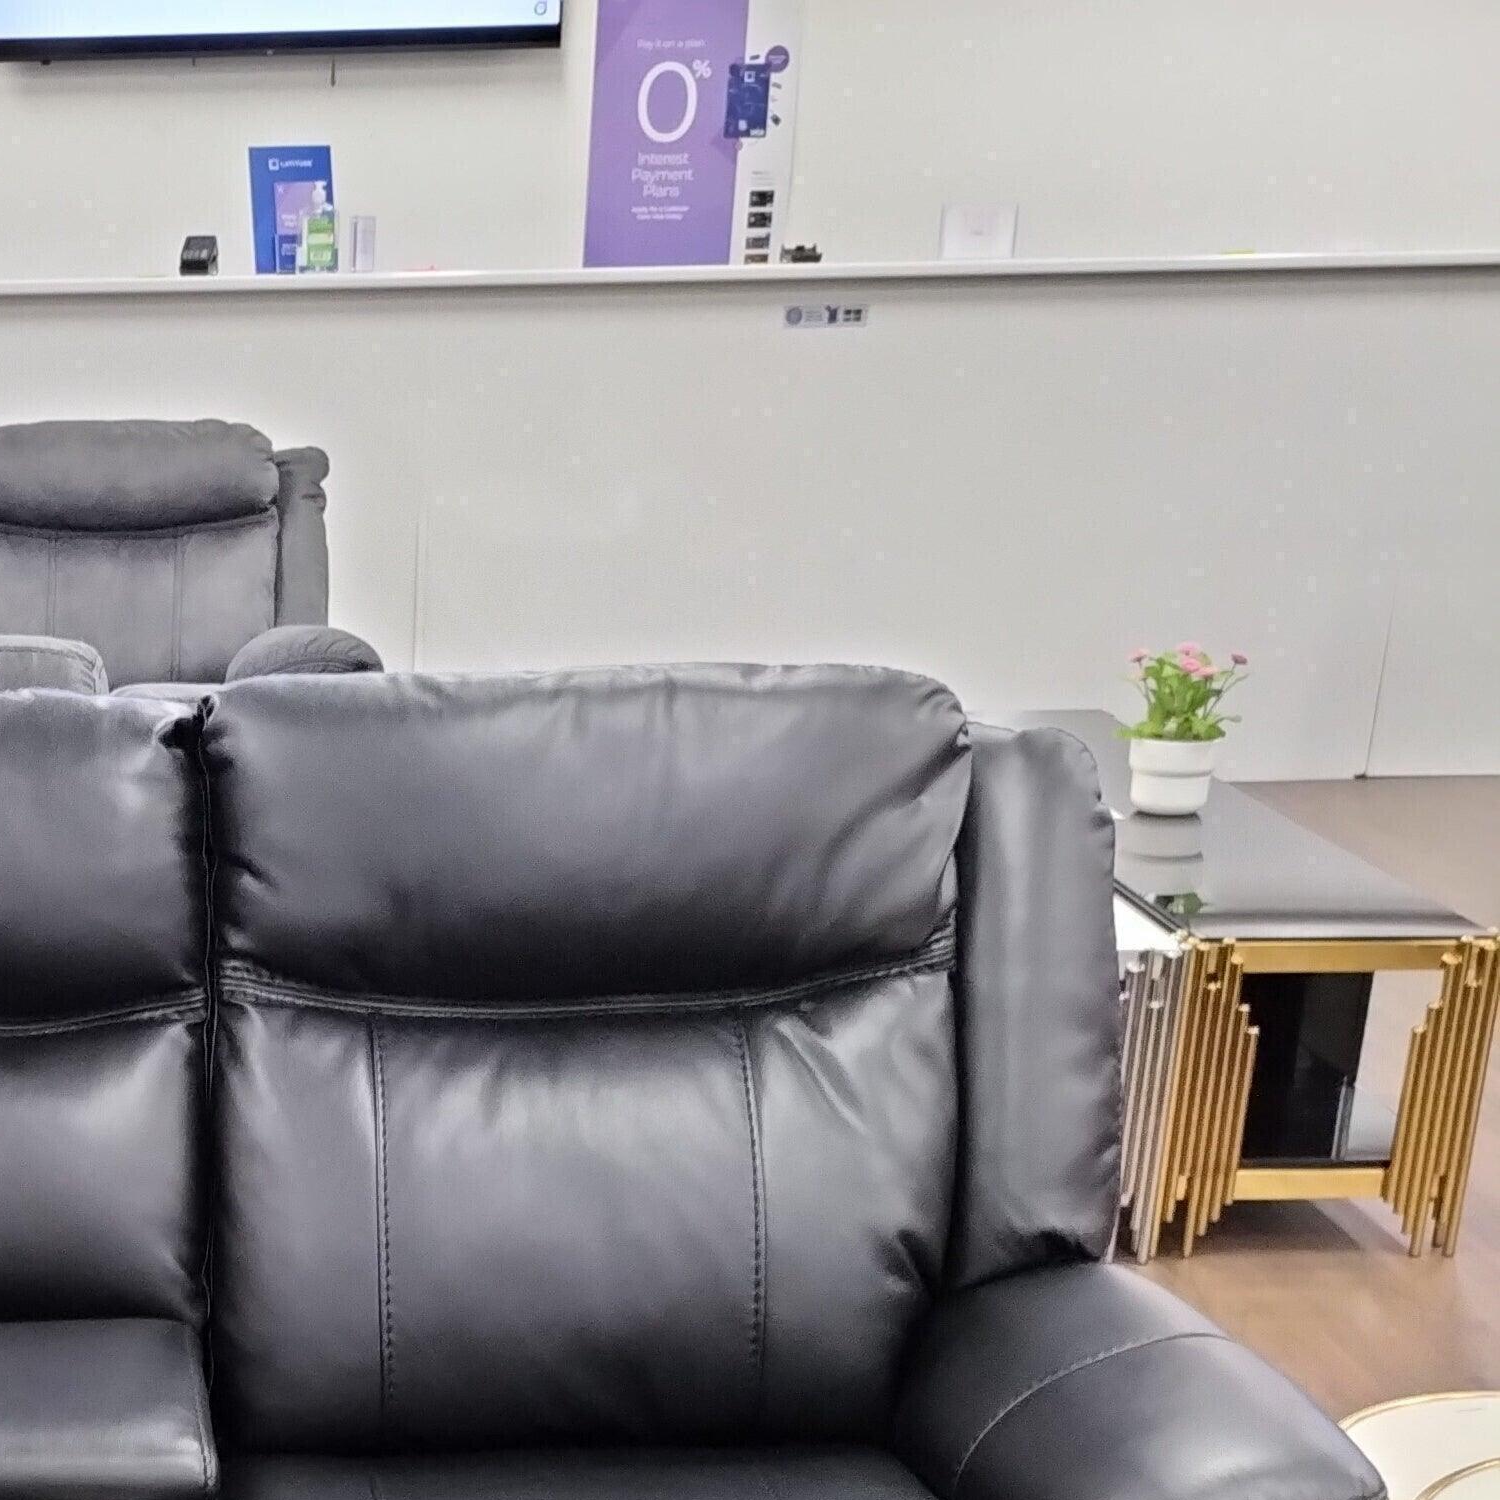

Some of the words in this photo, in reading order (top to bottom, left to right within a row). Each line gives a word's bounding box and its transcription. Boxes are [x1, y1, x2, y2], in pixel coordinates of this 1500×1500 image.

[638, 59, 712, 142] 0%
[638, 151, 691, 166] Interest
[631, 168, 694, 184] Payment
[642, 184, 680, 198] Plans
